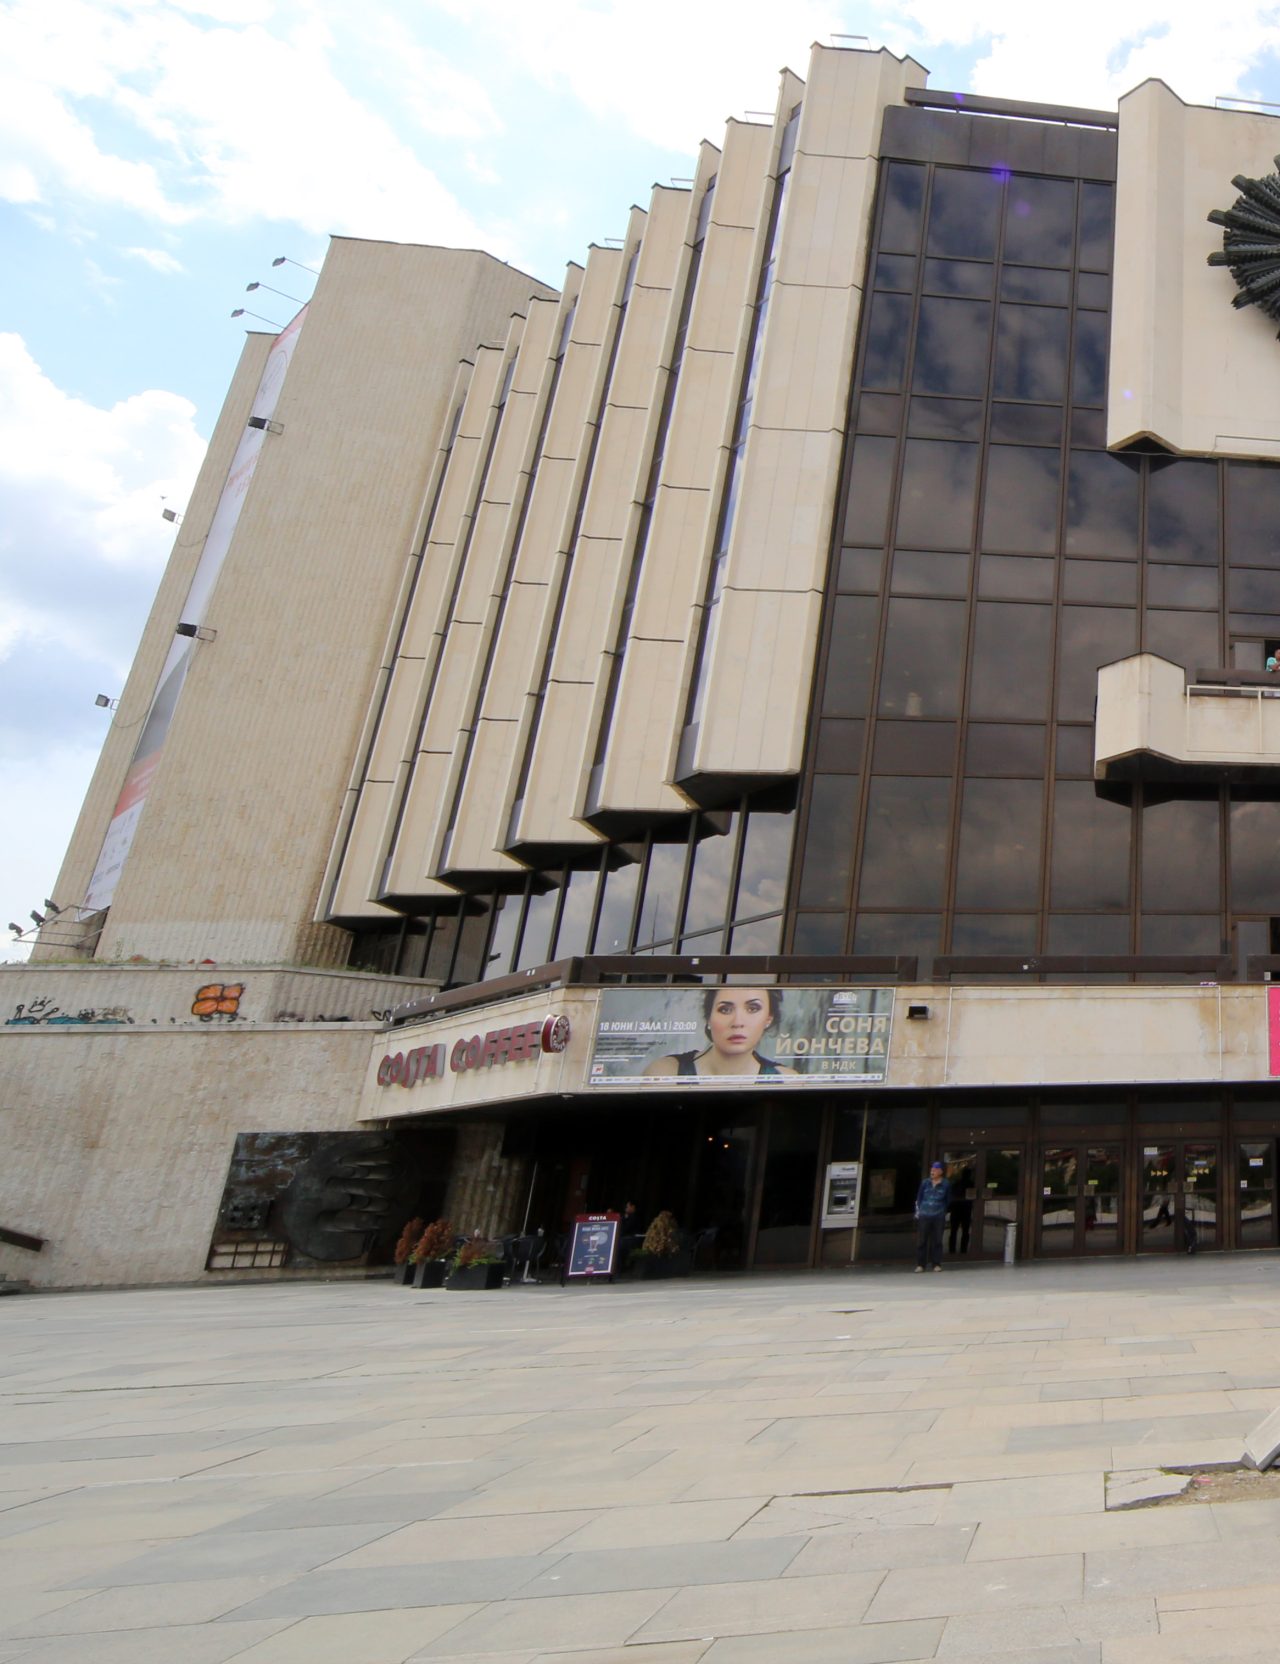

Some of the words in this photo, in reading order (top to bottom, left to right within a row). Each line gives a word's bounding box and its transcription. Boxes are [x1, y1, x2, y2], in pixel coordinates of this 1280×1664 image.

[600, 1021, 609, 1031] 18
[611, 1021, 633, 1031] ЮНИ
[640, 1021, 661, 1031] ЗАЛА
[673, 1021, 697, 1030] 20:00
[826, 1017, 887, 1033] СОНЯ
[775, 1033, 884, 1055] ЙОНЧЕВА
[377, 1043, 446, 1088] COSTA
[450, 1021, 544, 1072] COFFEE
[821, 1061, 828, 1070] В
[831, 1061, 857, 1071] НДК
